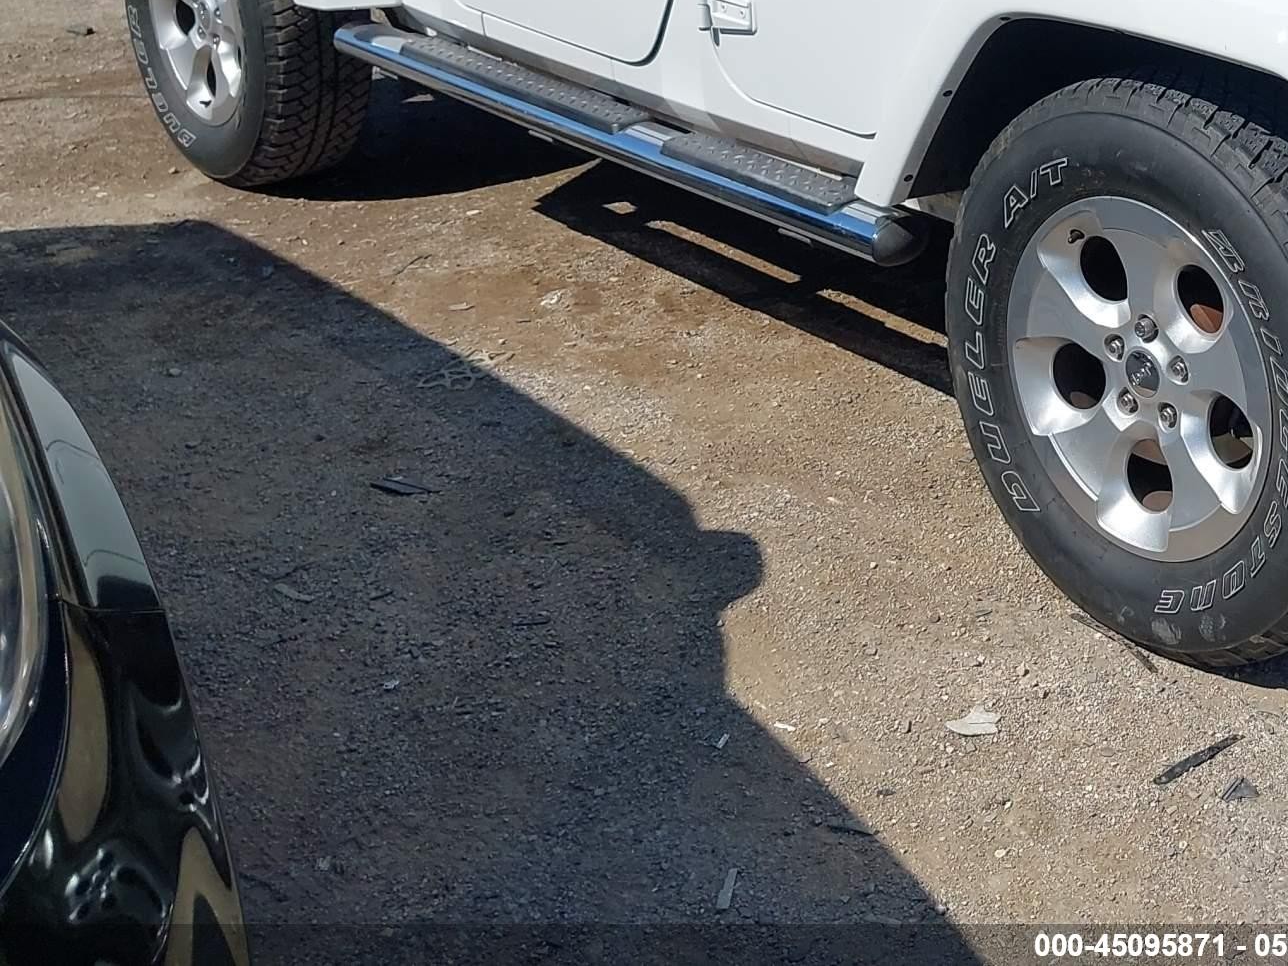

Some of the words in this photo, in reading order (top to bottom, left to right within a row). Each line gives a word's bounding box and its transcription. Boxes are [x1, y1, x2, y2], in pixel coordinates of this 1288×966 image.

[127, 4, 198, 148] DUELER
[961, 232, 1041, 514] DUELER
[1001, 156, 1069, 229] A/T
